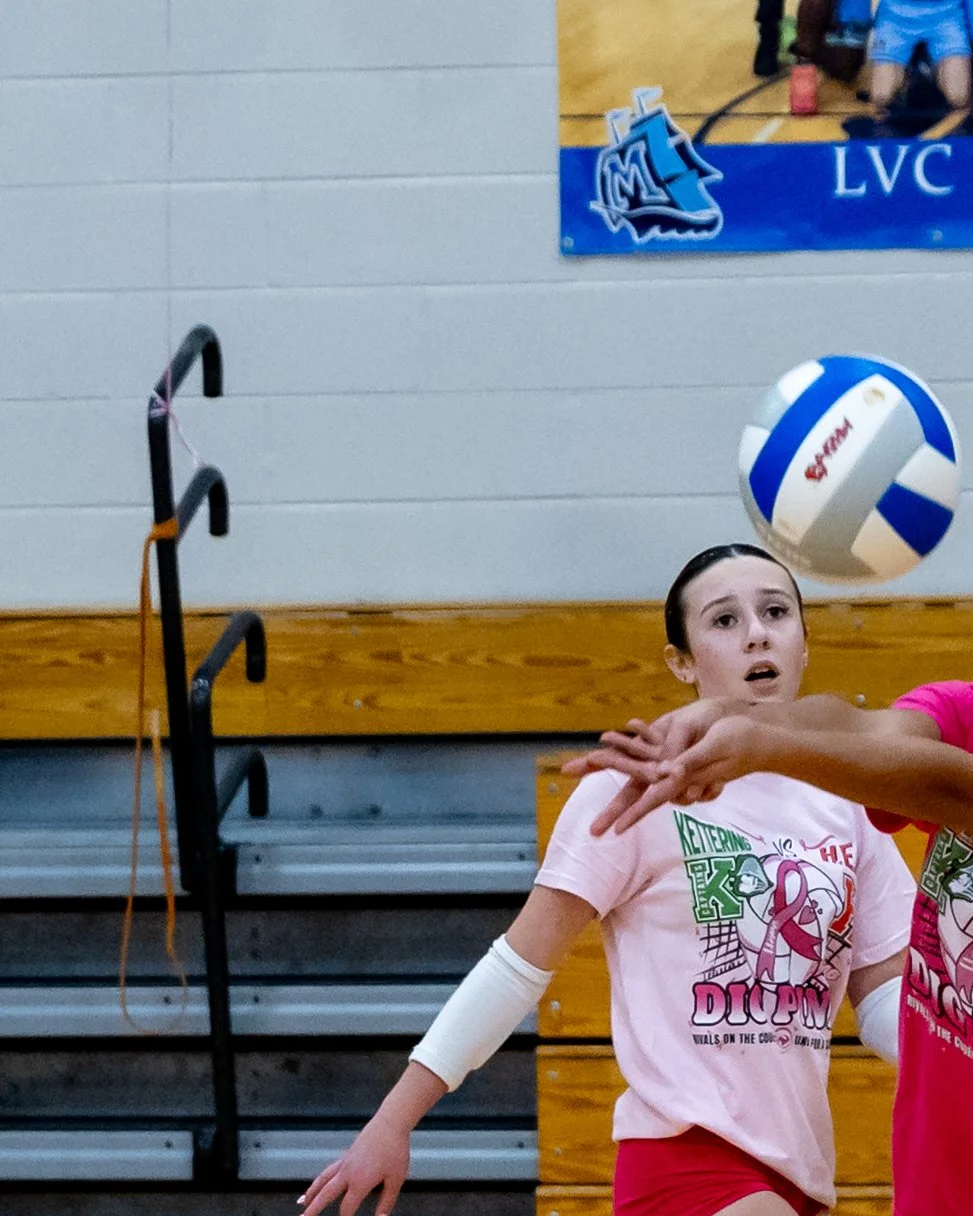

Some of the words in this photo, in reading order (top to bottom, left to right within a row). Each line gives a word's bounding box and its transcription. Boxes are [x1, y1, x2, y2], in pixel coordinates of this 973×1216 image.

[834, 142, 953, 197] LVC
[673, 810, 752, 857] KETTERING
[684, 856, 744, 923] K
[723, 1033, 736, 1045] ON
[740, 1033, 755, 1045] THE
